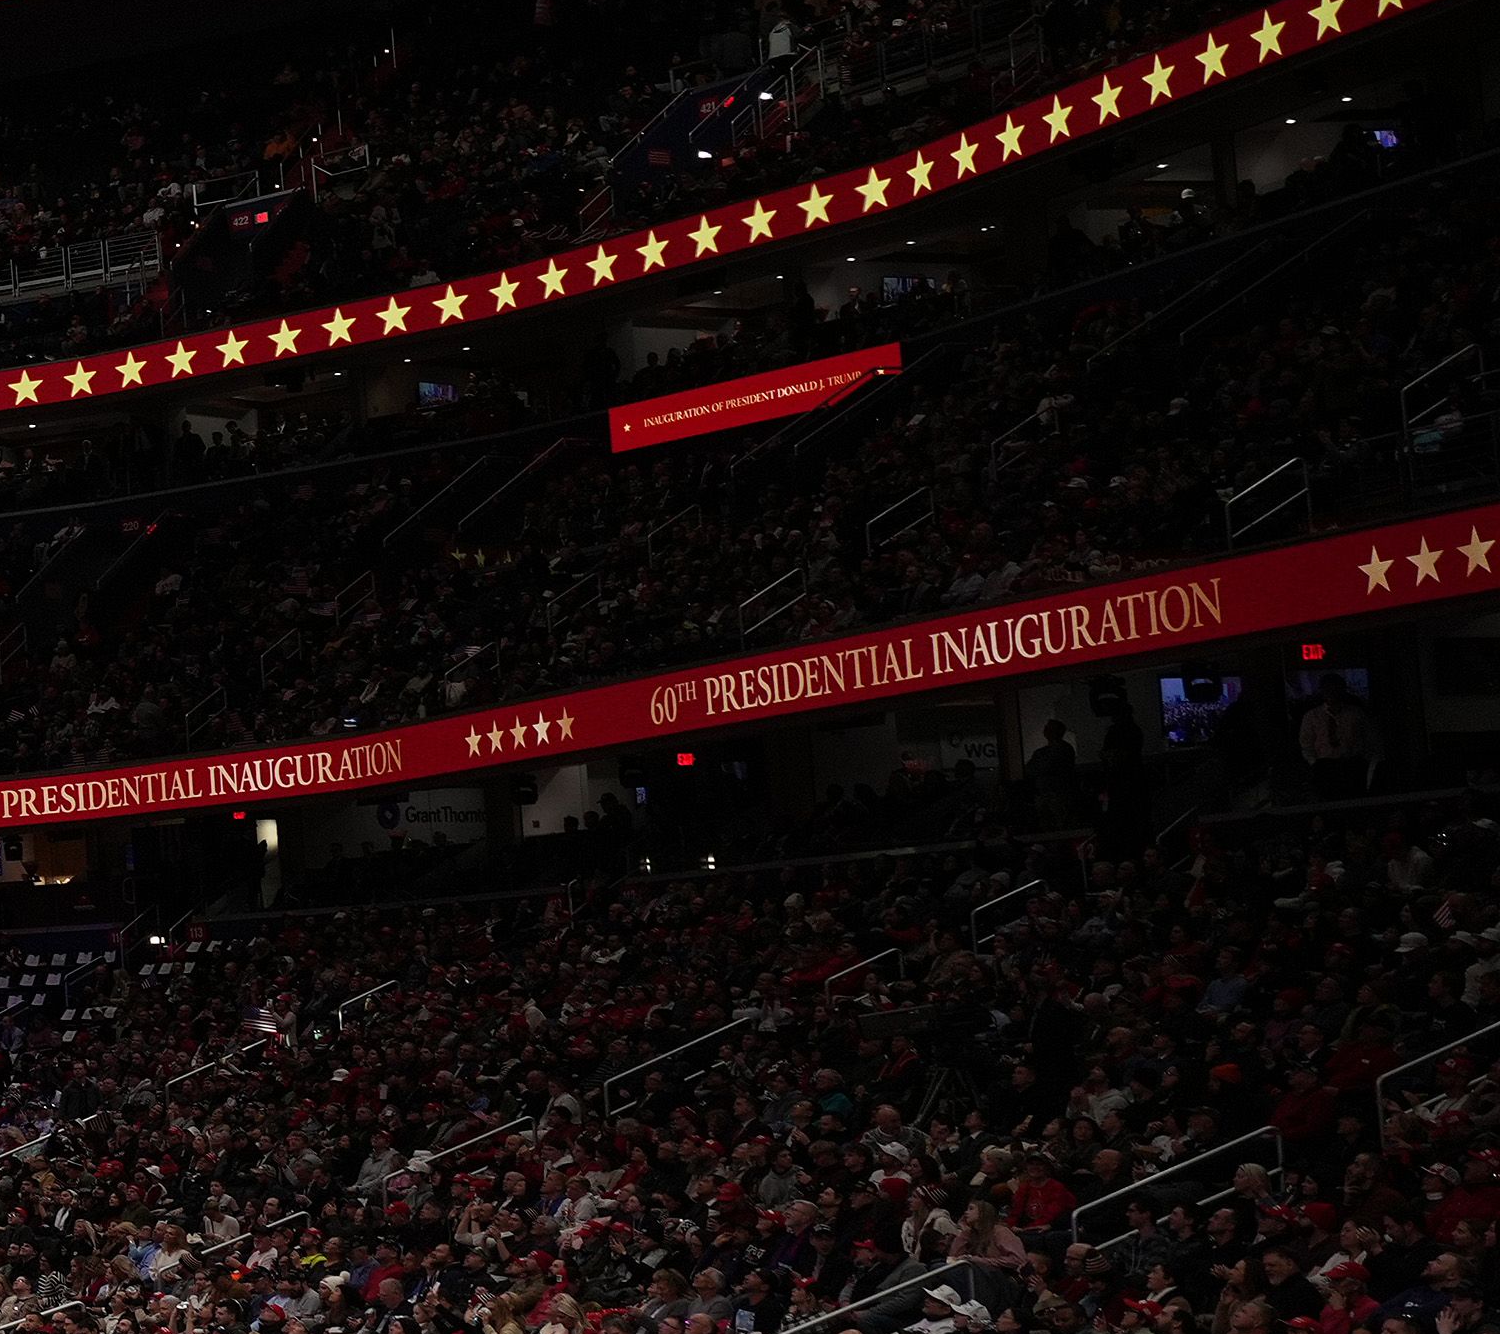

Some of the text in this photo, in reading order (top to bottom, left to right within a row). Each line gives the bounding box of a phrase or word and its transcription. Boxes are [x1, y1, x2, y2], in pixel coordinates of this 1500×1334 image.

[643, 404, 710, 429] INAUGURATION
[712, 401, 724, 415] OF
[726, 391, 775, 411] PRESIDENT
[778, 382, 817, 401] DONALD
[827, 370, 862, 387] TRUMP
[650, 577, 1222, 727] 60TH PRESIDENTIAL INAUGURATION
[1, 770, 202, 818] PRESIDENTIAL
[209, 739, 404, 797] INAUGURATION
